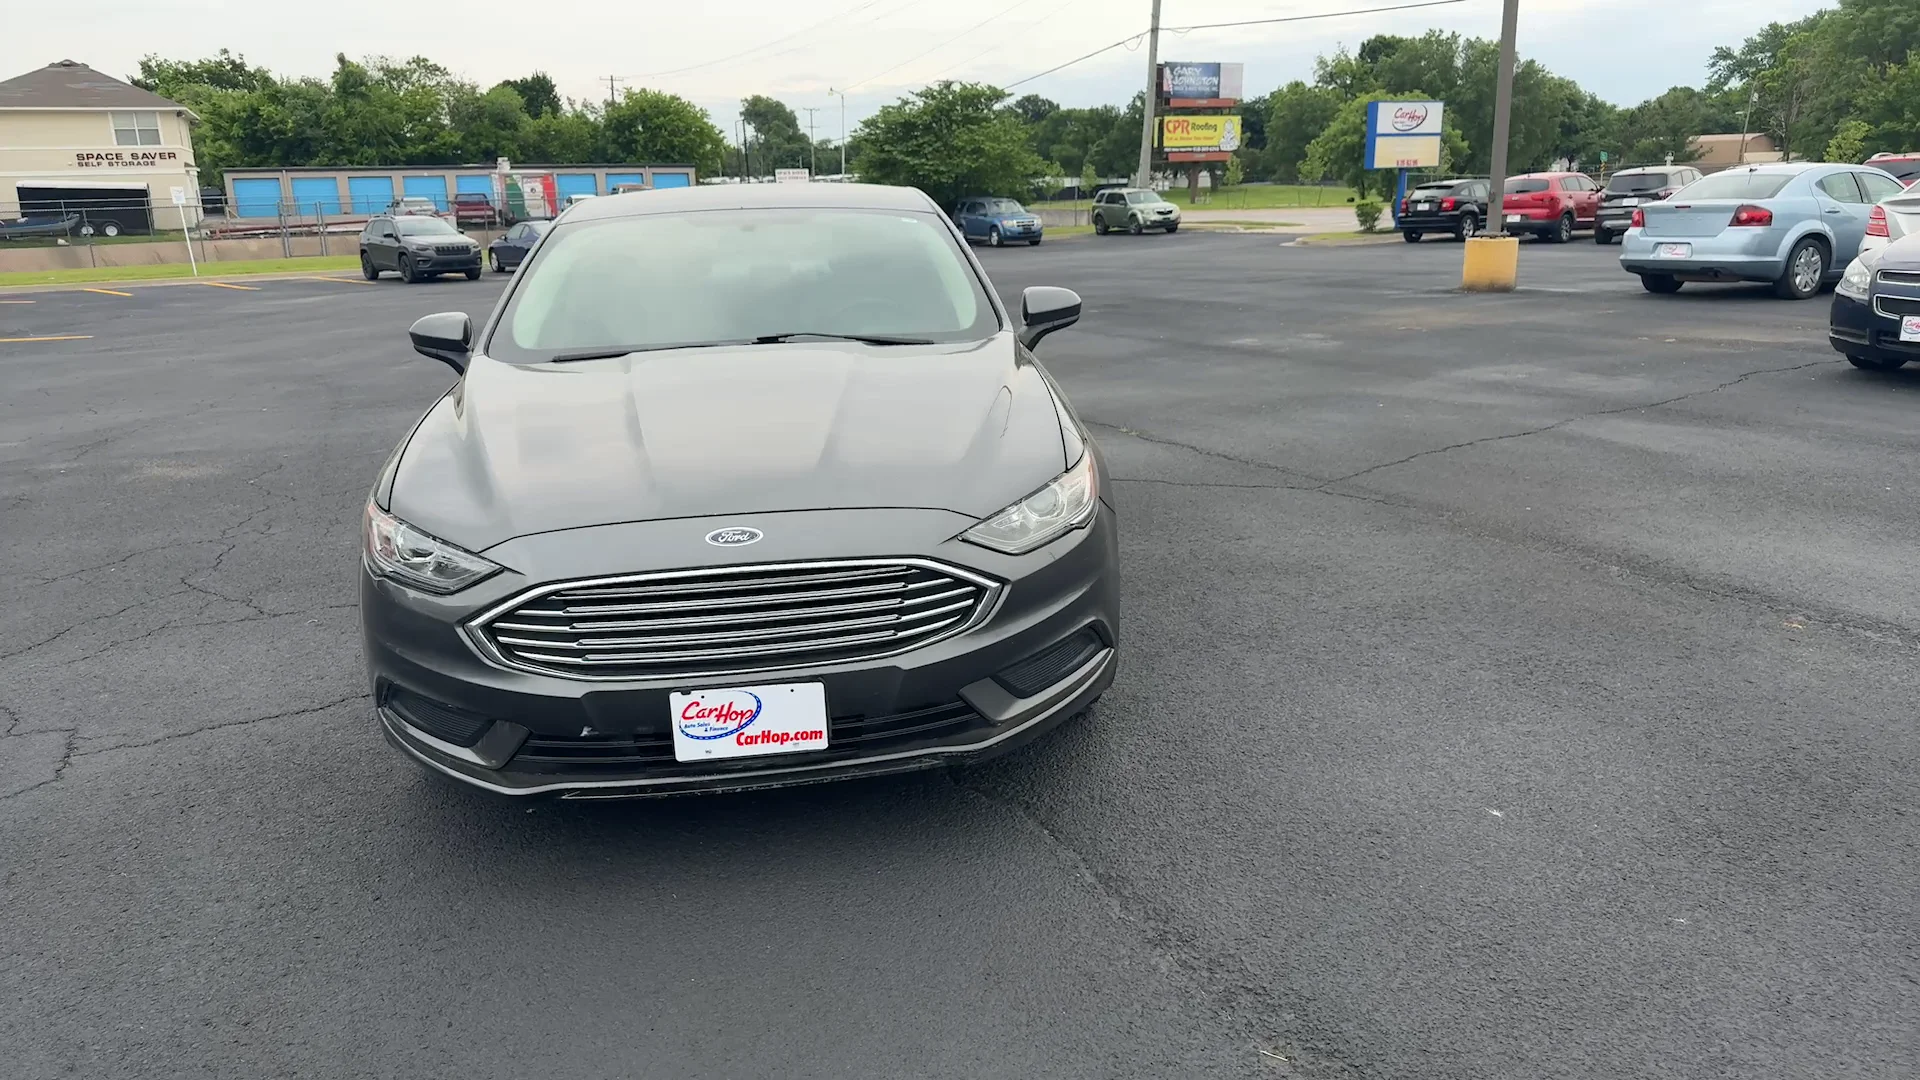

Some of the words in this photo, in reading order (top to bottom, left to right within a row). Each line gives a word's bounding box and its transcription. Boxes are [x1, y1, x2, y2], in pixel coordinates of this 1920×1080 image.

[1173, 66, 1203, 76] GARY
[1173, 75, 1220, 86] JOHNSTON
[1394, 107, 1424, 125] CarHop
[1166, 119, 1191, 135] CPR
[1191, 122, 1217, 133] Roofing
[76, 153, 124, 161] SPACE
[131, 152, 177, 160] SAVER
[718, 530, 750, 543] Ford
[681, 701, 754, 729] CarHop
[736, 729, 823, 746] CarHop.com
